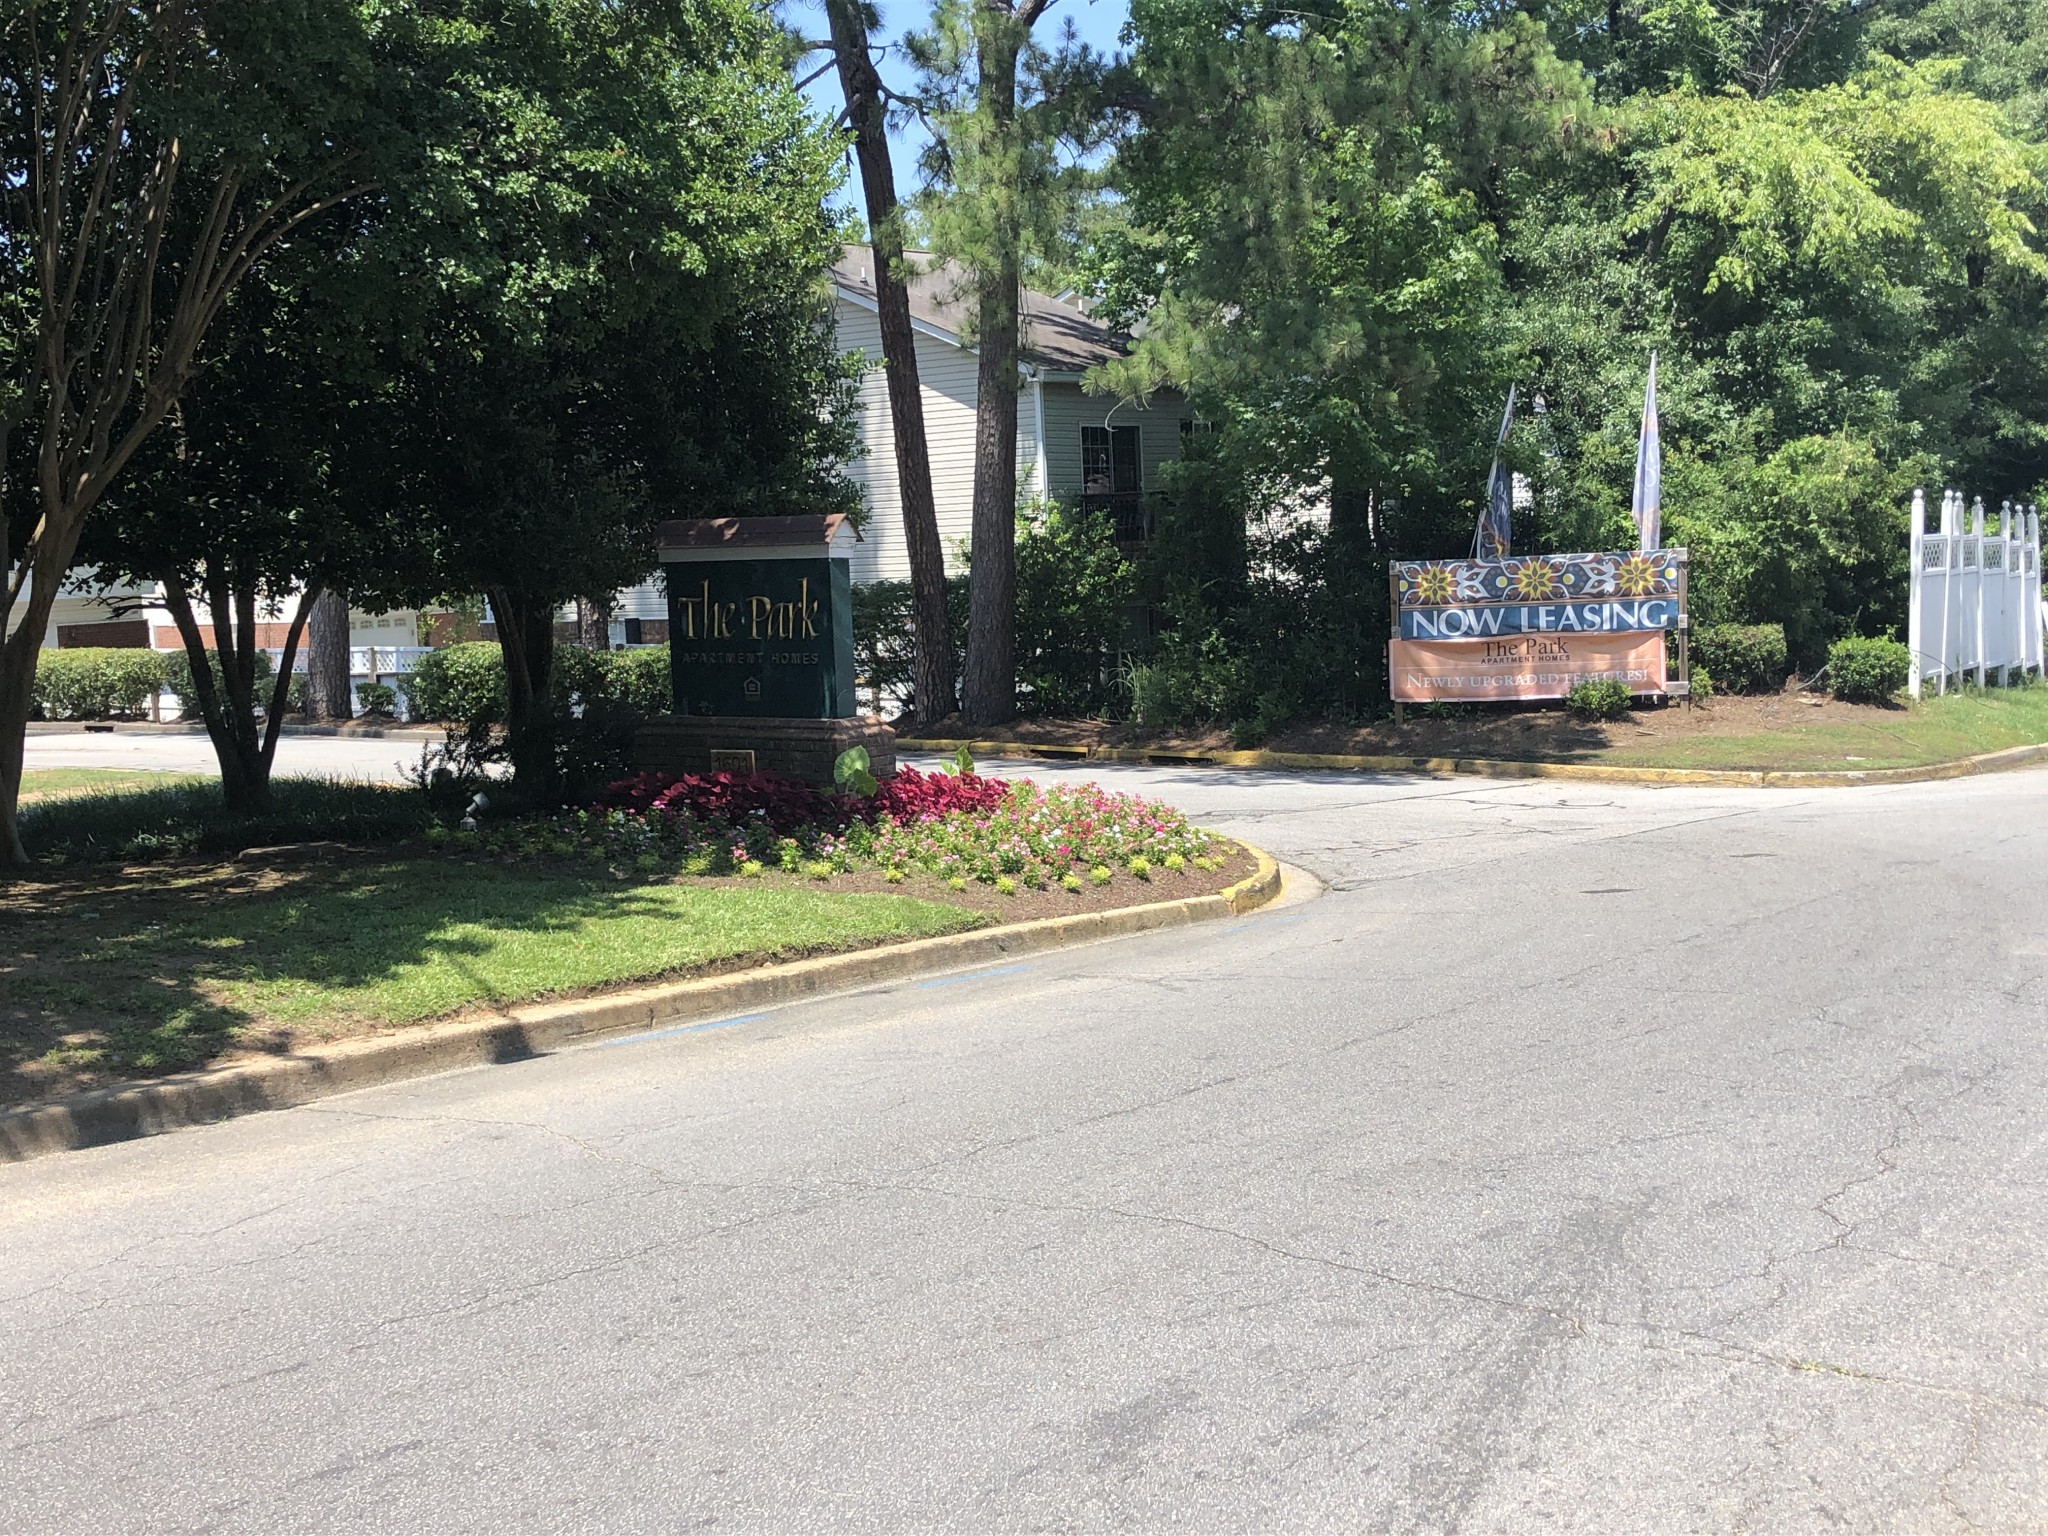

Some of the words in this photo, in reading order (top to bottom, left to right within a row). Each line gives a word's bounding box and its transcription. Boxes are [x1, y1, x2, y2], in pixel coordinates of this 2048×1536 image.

[678, 578, 736, 640] The
[746, 577, 820, 641] Park
[1412, 607, 1504, 637] NOW
[1520, 600, 1668, 633] LEASING
[1481, 640, 1518, 657] The
[1525, 637, 1569, 655] Park
[682, 652, 765, 664] APARTMENT
[771, 652, 819, 664] HOMES
[1480, 656, 1536, 664] APARTMENT
[1538, 654, 1571, 662] HOMES
[1406, 672, 1465, 689] NEWLY
[1470, 673, 1560, 687] UPGRADED
[1564, 669, 1648, 684] FEATURES!
